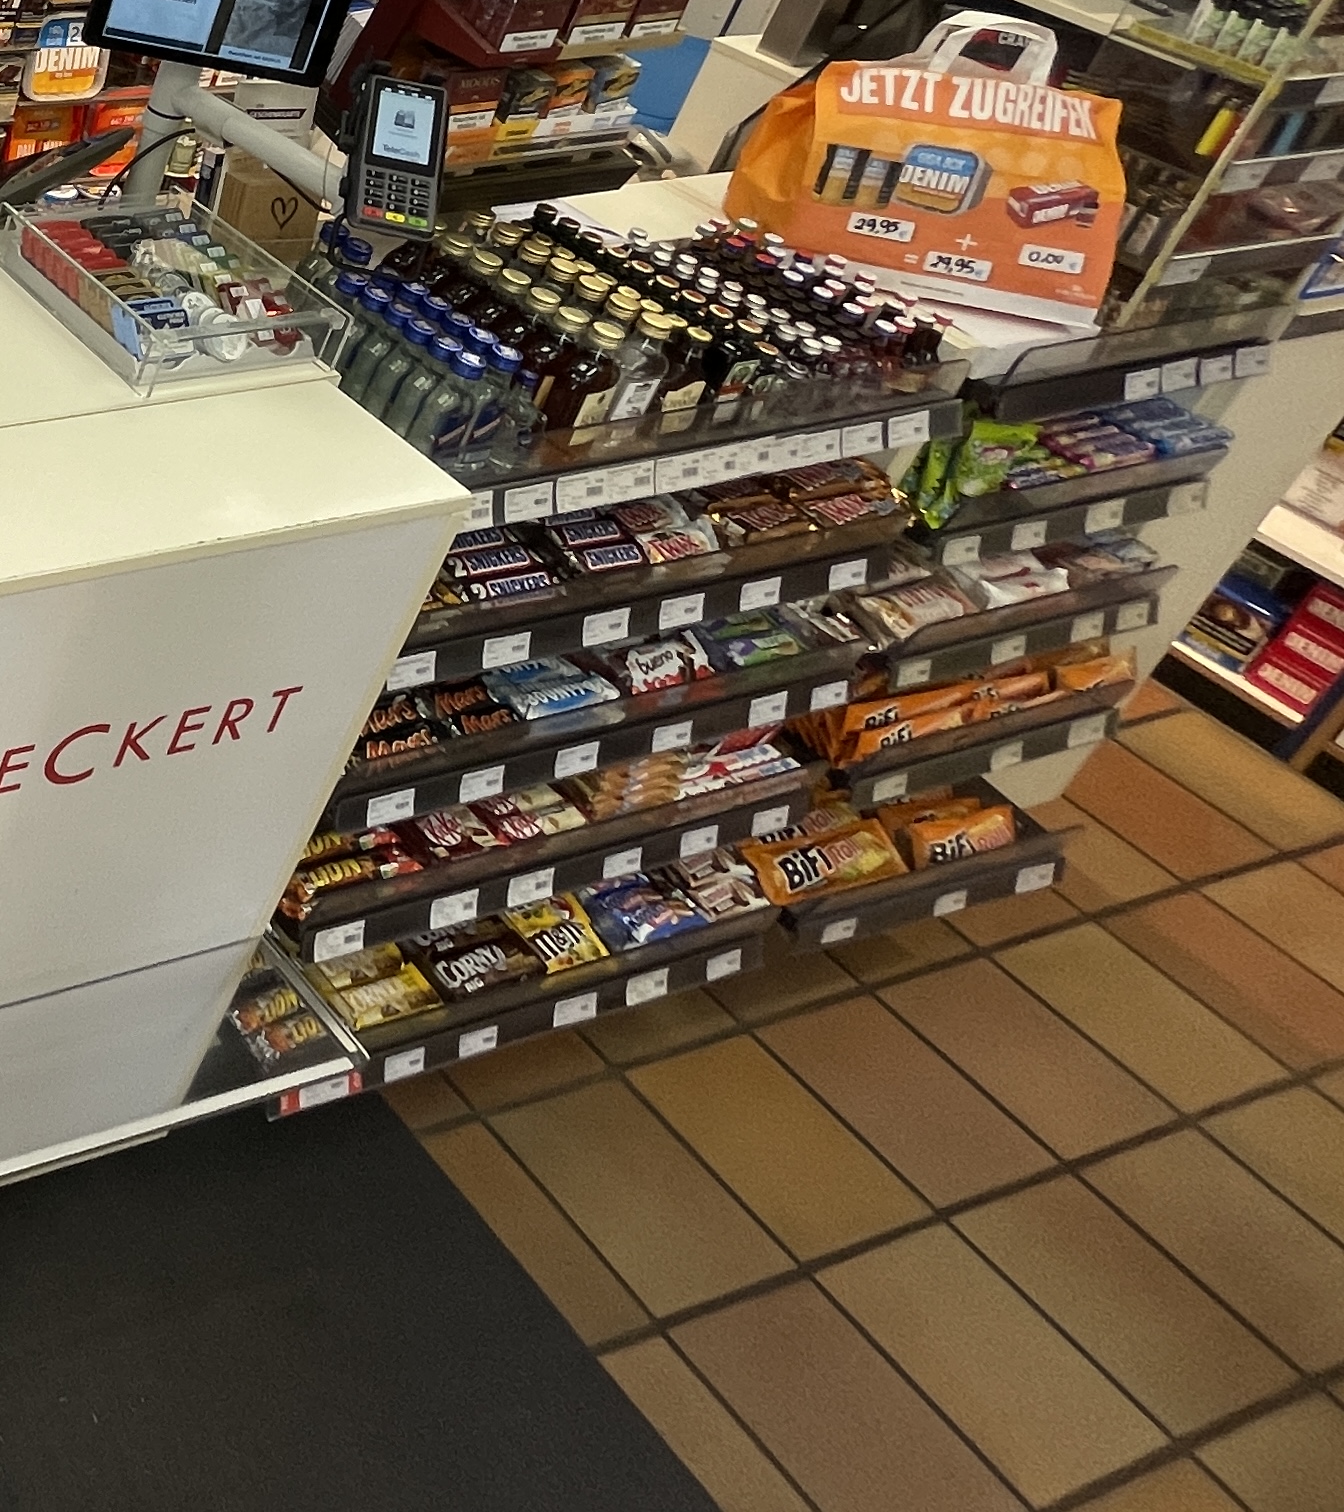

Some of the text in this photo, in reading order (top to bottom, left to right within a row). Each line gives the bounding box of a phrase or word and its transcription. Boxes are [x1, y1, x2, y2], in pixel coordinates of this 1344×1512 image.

[34, 47, 99, 74] DENIM
[840, 68, 1097, 140] JETZT ZUGREIFEN
[899, 163, 971, 195] DENIM
[466, 547, 530, 573] SNICKERS
[648, 534, 700, 561] Twix
[636, 651, 674, 675] bueno
[460, 709, 512, 735] Mars
[930, 836, 977, 865] BiFi
[778, 848, 833, 892] BiFi
[435, 945, 507, 983] CORNY
